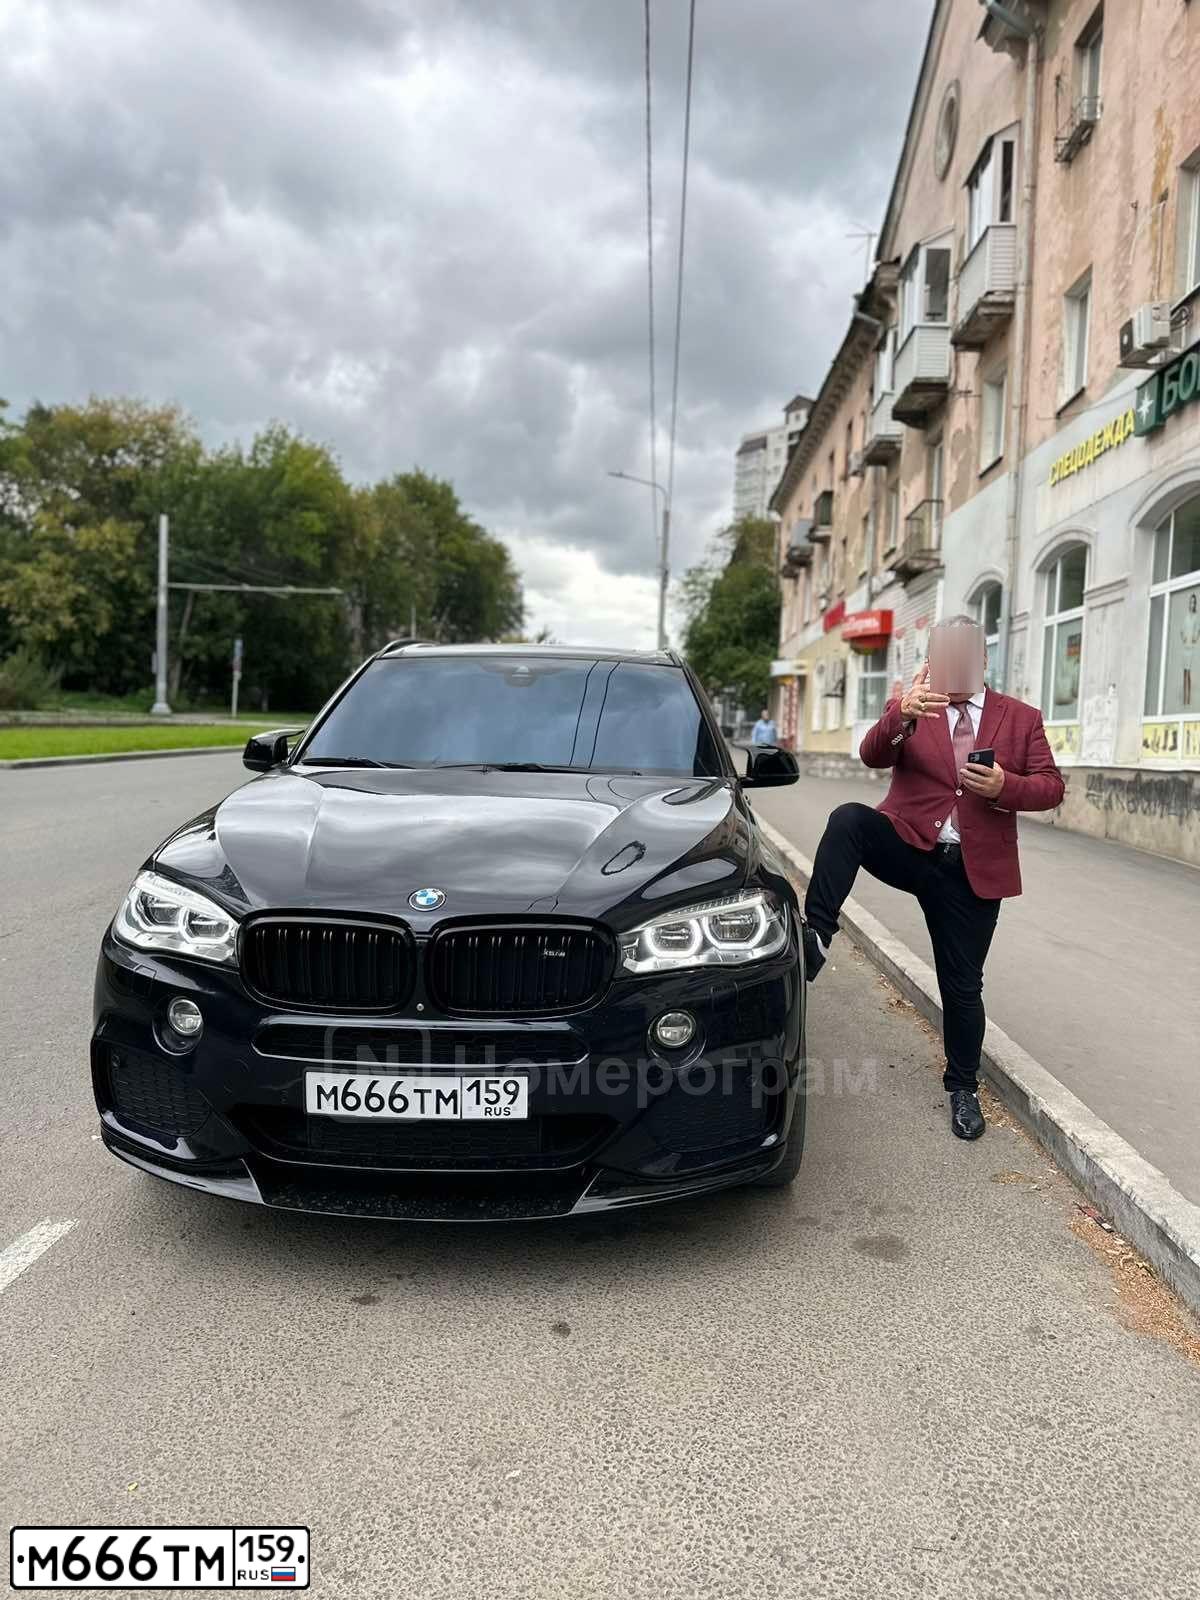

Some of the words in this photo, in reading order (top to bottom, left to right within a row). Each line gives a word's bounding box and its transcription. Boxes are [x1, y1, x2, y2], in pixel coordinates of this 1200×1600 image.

[1161, 351, 1200, 414] БО
[1048, 407, 1136, 487] СПЕЦОДЕЖДА
[316, 1078, 458, 1115] М666ТМ
[466, 1079, 521, 1106] 159
[483, 1106, 512, 1117] RUS
